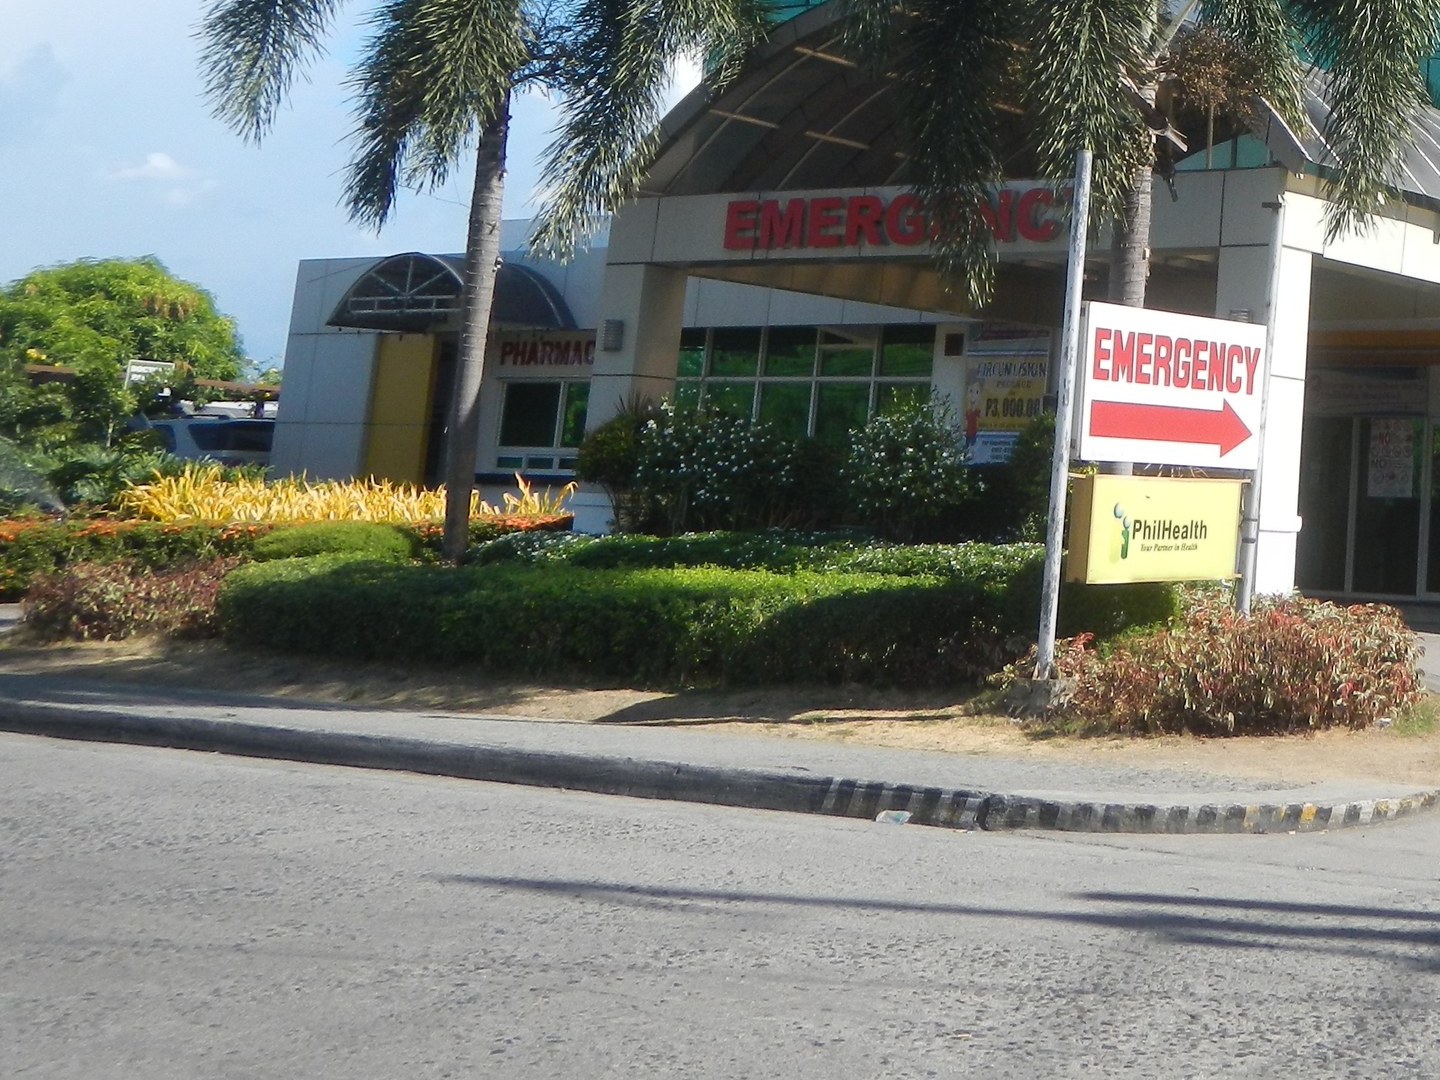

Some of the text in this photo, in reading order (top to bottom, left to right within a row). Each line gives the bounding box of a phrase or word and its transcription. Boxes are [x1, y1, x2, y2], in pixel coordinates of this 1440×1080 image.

[724, 187, 1075, 250] EMERGNC
[501, 340, 596, 366] PHARMAC
[1093, 327, 1261, 395] EMERGENCY
[1132, 520, 1207, 540] PhilHealth
[1140, 543, 1198, 552] Your Partner in Health
